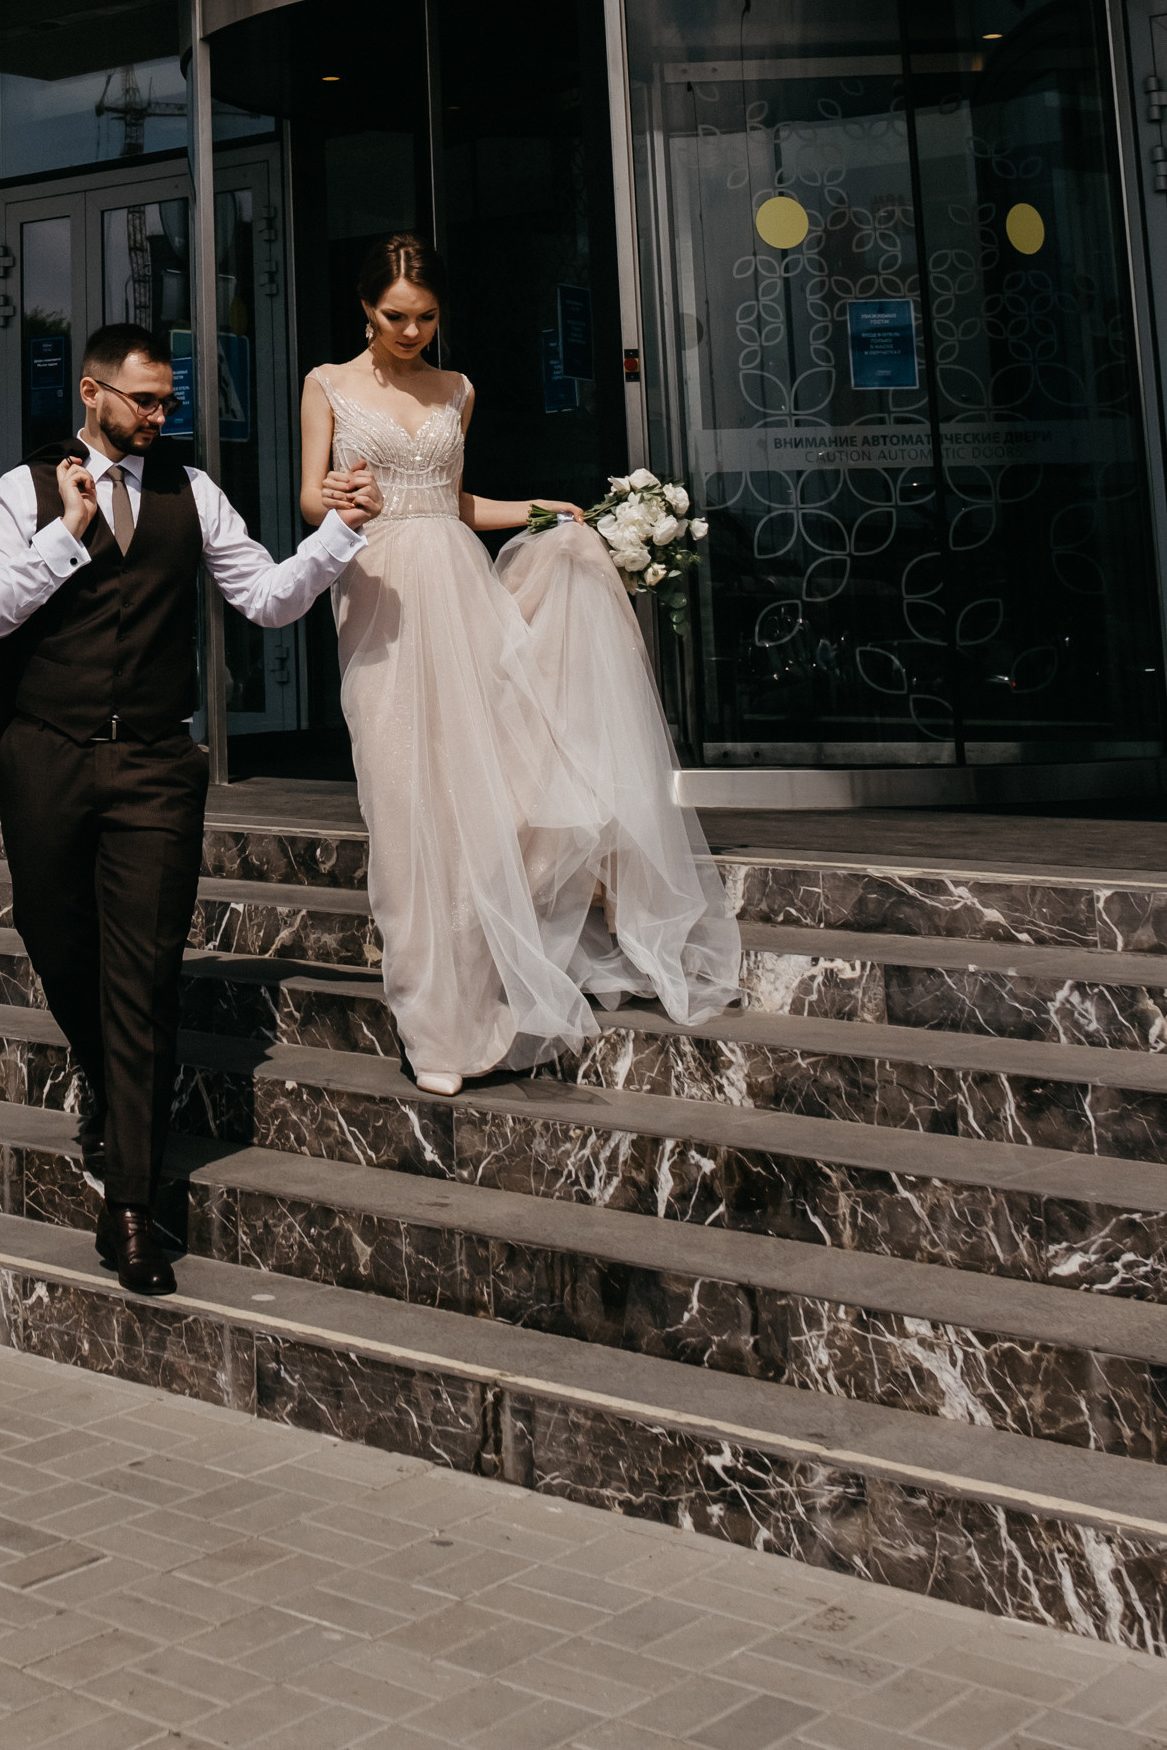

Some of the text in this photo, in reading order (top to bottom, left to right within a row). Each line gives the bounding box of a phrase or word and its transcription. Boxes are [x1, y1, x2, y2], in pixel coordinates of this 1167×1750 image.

[774, 430, 1053, 449] ВНИМАНИЕ АВТОМАТЧЕСКИЕ ДВЕРИ
[805, 450, 872, 463] CAUTION
[877, 446, 966, 461] AUTOMTIC
